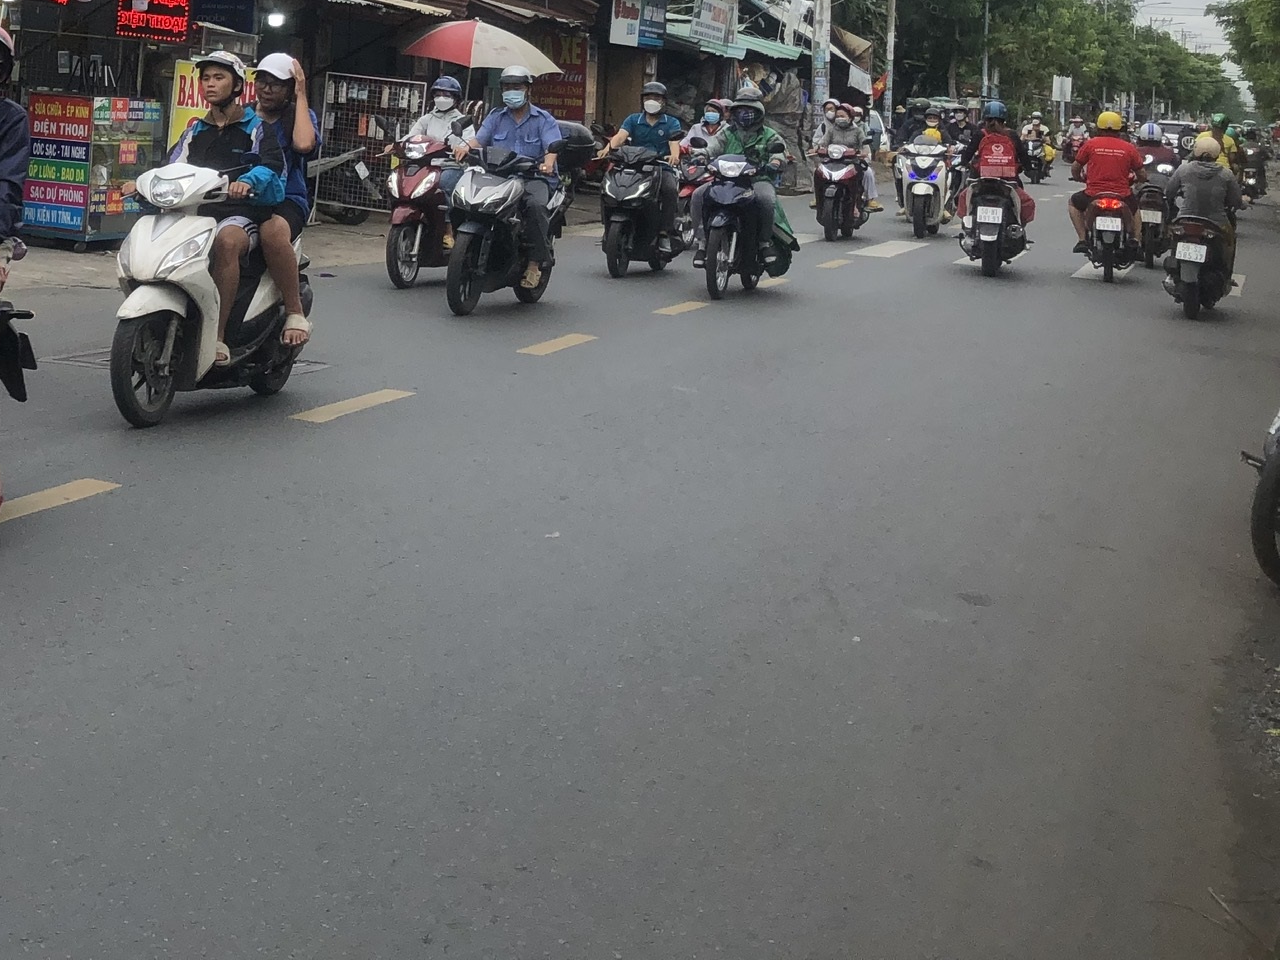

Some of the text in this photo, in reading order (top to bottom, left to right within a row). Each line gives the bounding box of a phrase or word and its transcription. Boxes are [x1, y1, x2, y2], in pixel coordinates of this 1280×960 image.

[560, 36, 582, 65] XE
[33, 118, 89, 139] ĐIỆN THOẠI
[30, 185, 84, 204] SẠC DỰ PHÒNG
